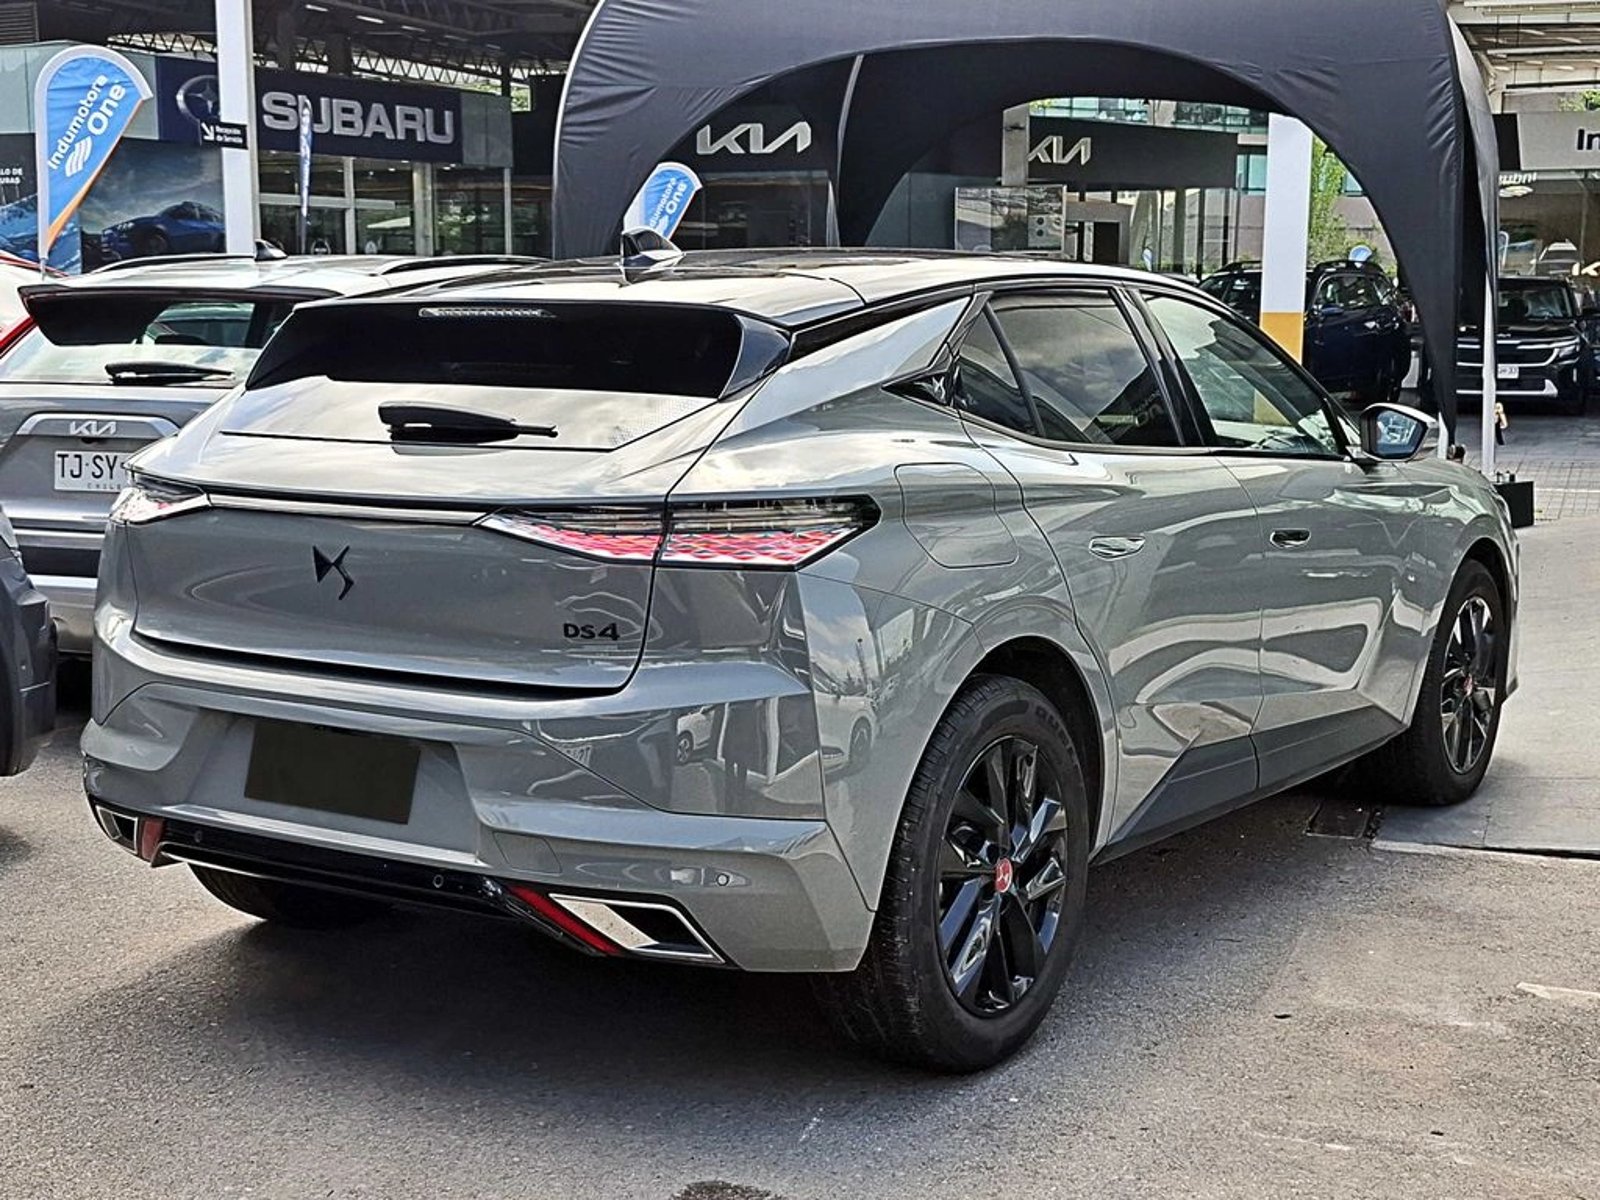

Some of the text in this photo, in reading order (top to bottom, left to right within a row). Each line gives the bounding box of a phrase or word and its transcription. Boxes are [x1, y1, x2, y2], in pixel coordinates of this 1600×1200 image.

[47, 74, 109, 170] Indumotora
[87, 84, 126, 136] One
[261, 91, 455, 144] SUBARU
[696, 121, 812, 154] KIA
[665, 183, 687, 215] One
[70, 420, 117, 436] KIA
[563, 622, 620, 641] DS4
